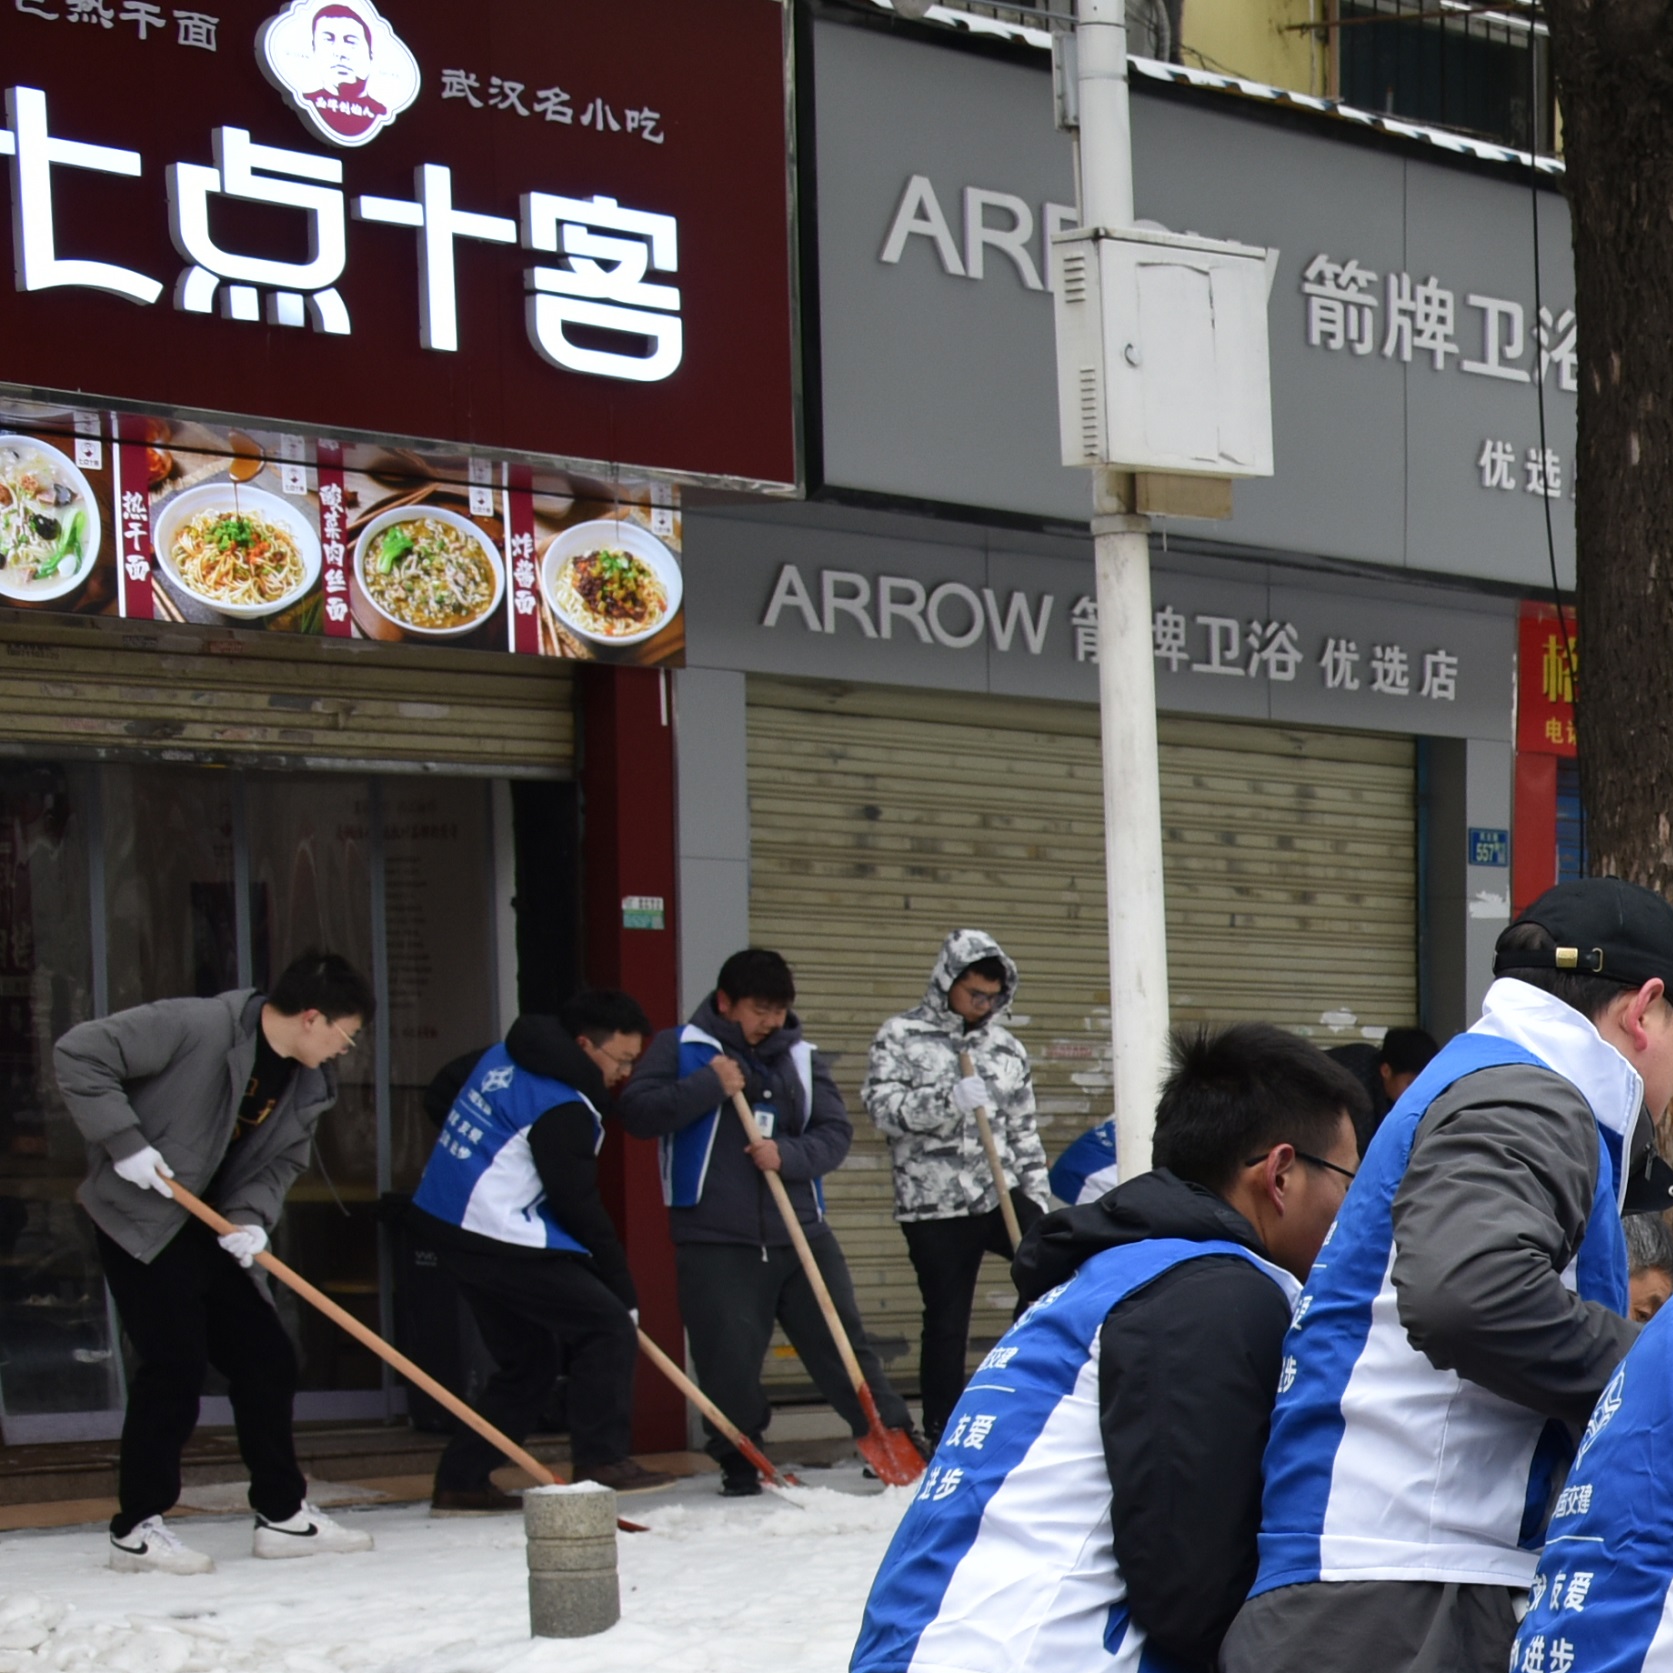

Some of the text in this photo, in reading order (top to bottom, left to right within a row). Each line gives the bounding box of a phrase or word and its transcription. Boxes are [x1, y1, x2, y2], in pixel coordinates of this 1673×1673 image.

[440, 68, 665, 144] 武汉名小吃
[0, 86, 684, 383] 七点十客
[1479, 438, 1578, 500] 优选
[122, 491, 150, 582] 热干面
[319, 483, 349, 622] 酸菜肉丝面
[512, 532, 537, 616] 炸酱面
[763, 564, 1053, 655] ARROW
[1320, 638, 1459, 701] 优选店
[945, 1413, 997, 1451] 友爱
[1549, 1570, 1595, 1613] 友爱
